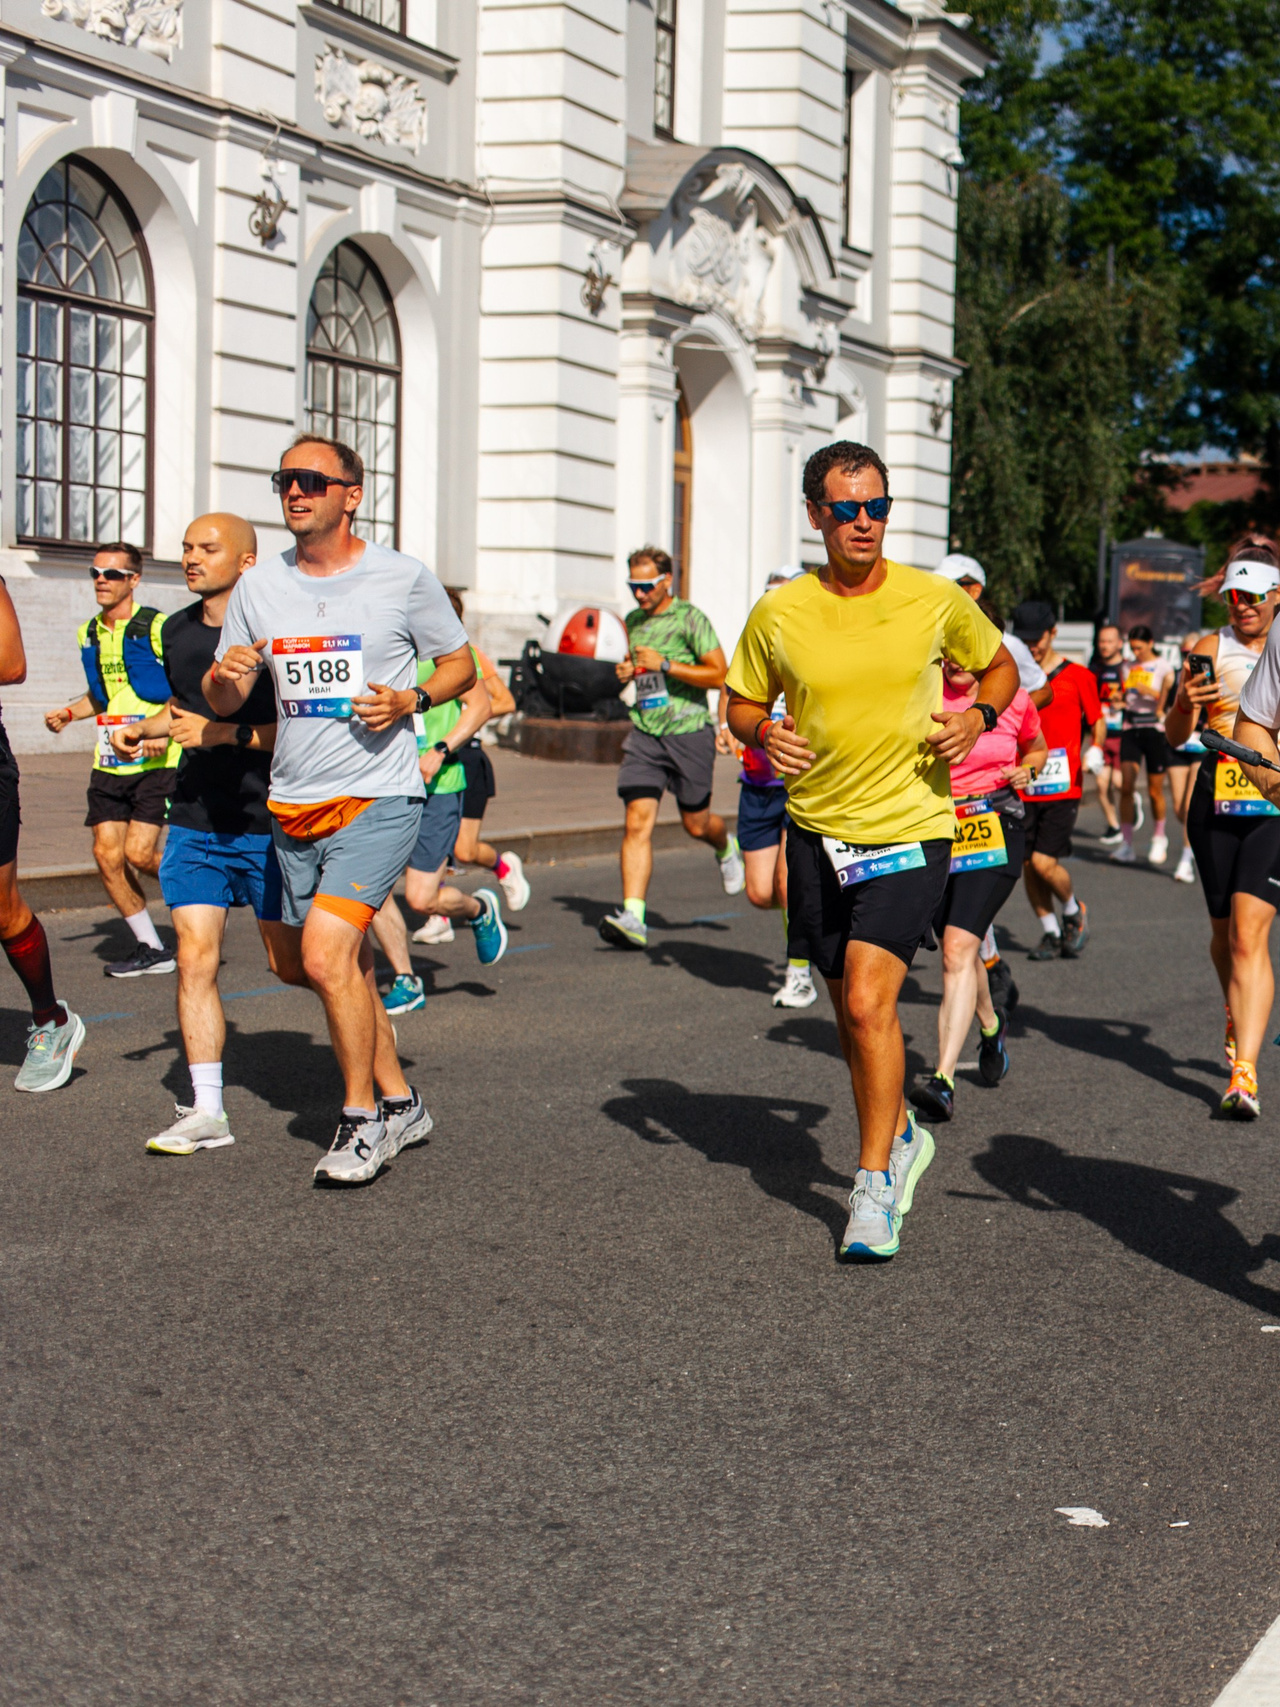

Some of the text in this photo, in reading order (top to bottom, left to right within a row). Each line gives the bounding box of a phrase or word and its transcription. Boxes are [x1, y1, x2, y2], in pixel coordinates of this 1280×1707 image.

[322, 640, 336, 649] 21,1
[286, 659, 351, 685] 5188
[309, 686, 331, 694] ИВАН
[289, 702, 299, 715] D
